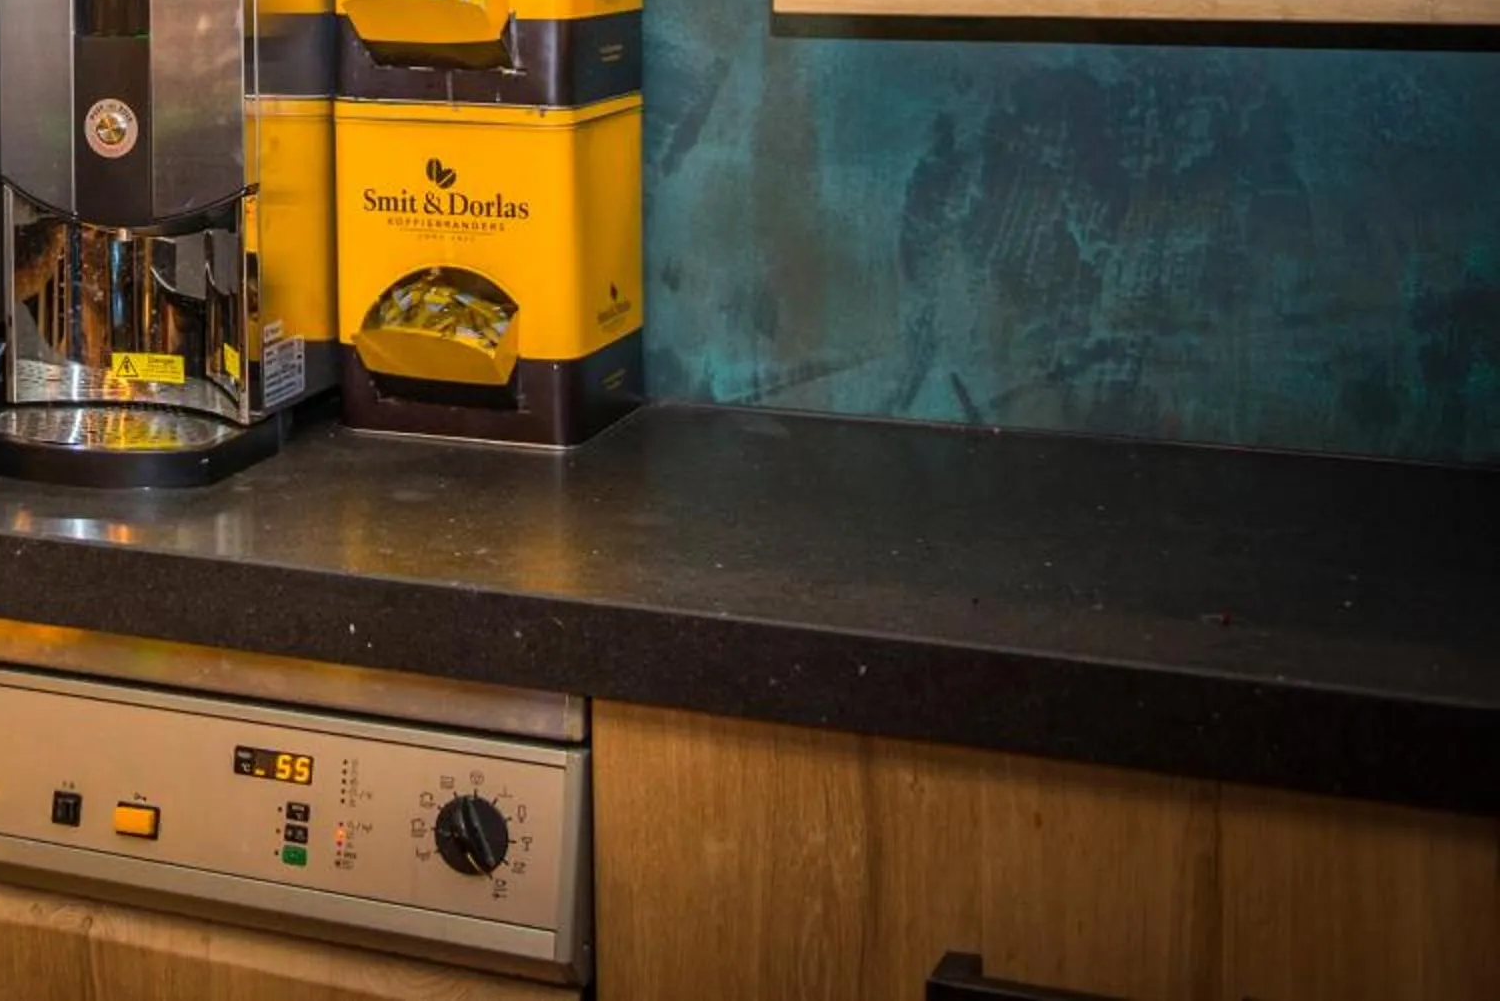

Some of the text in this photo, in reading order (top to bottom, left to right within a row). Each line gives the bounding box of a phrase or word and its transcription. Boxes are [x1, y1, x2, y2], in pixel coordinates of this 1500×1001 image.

[363, 188, 529, 220] Smit & Dorlas
[275, 753, 311, 783] 55
